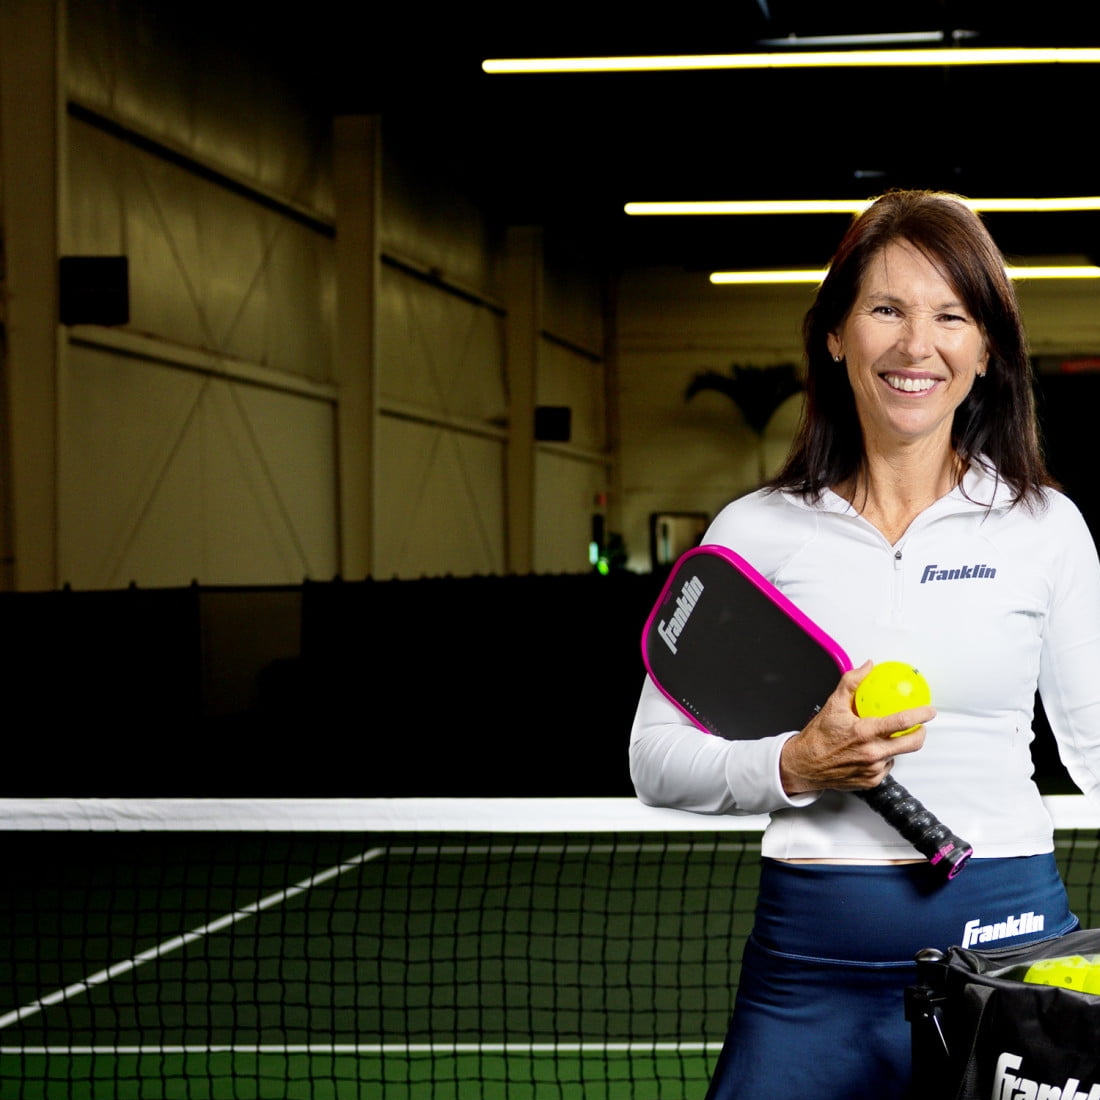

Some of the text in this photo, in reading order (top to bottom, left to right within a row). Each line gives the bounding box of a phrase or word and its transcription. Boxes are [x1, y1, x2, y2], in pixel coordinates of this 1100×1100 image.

[920, 564, 997, 584] Franklin
[657, 575, 705, 655] Franklin
[961, 911, 1044, 949] Franklin
